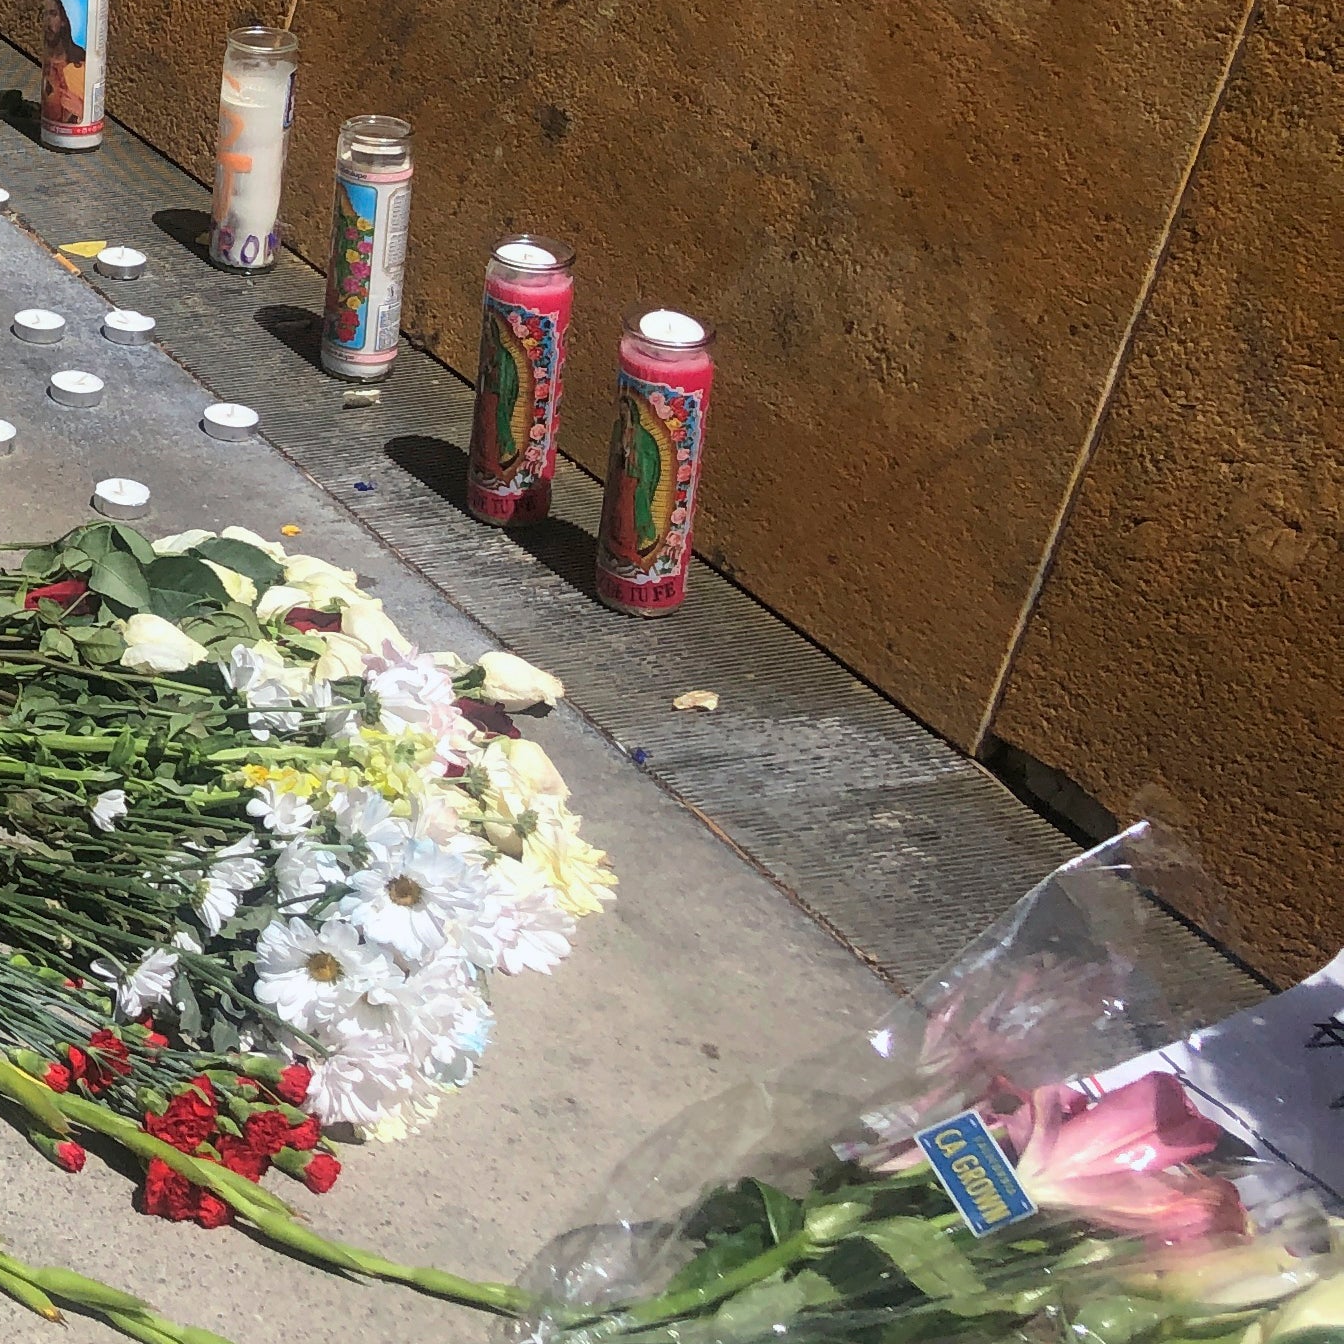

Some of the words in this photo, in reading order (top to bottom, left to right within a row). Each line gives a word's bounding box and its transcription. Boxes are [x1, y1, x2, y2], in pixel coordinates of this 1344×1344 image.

[629, 586, 648, 603] TU
[652, 581, 676, 602] FE
[935, 1128, 968, 1160] CA
[951, 1154, 1011, 1225] GROWN
